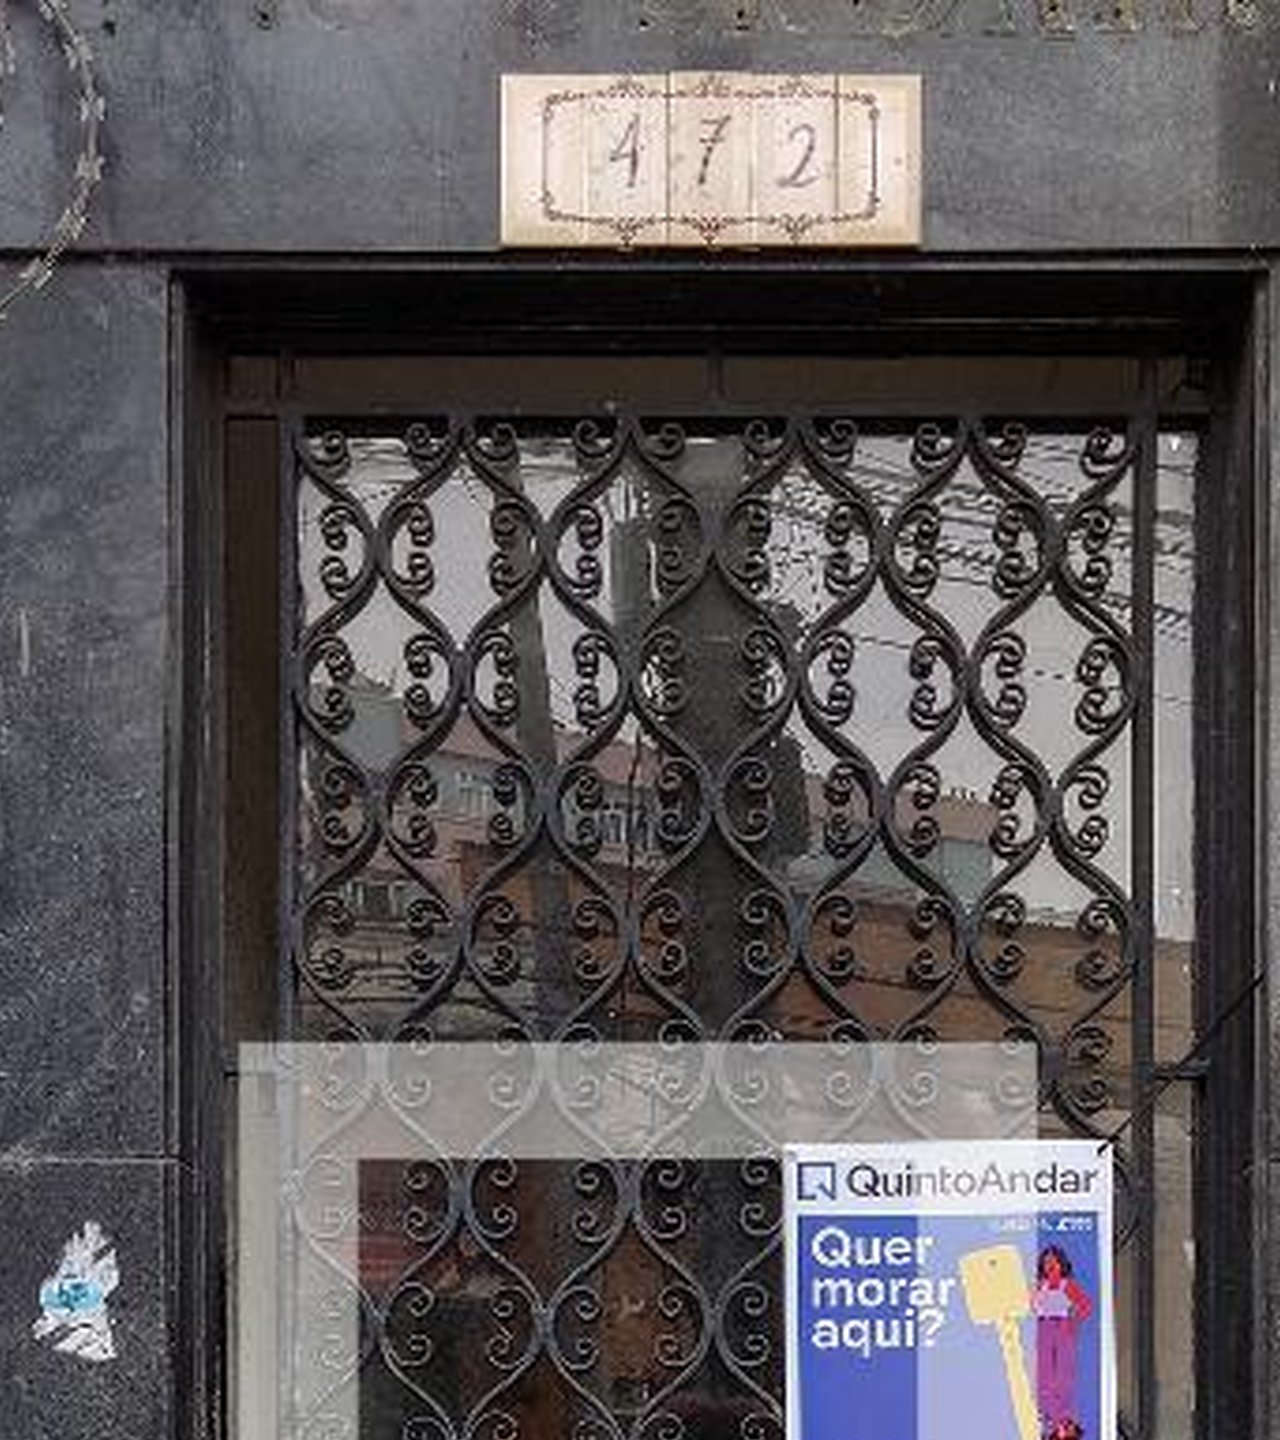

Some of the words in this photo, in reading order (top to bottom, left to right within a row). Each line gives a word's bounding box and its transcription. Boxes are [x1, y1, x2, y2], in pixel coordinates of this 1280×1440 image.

[609, 113, 822, 188] 472
[846, 1163, 1099, 1197] QuintoAndar
[811, 1226, 934, 1268] Quer
[811, 1278, 956, 1307] morar
[811, 1309, 944, 1358] aqui?
